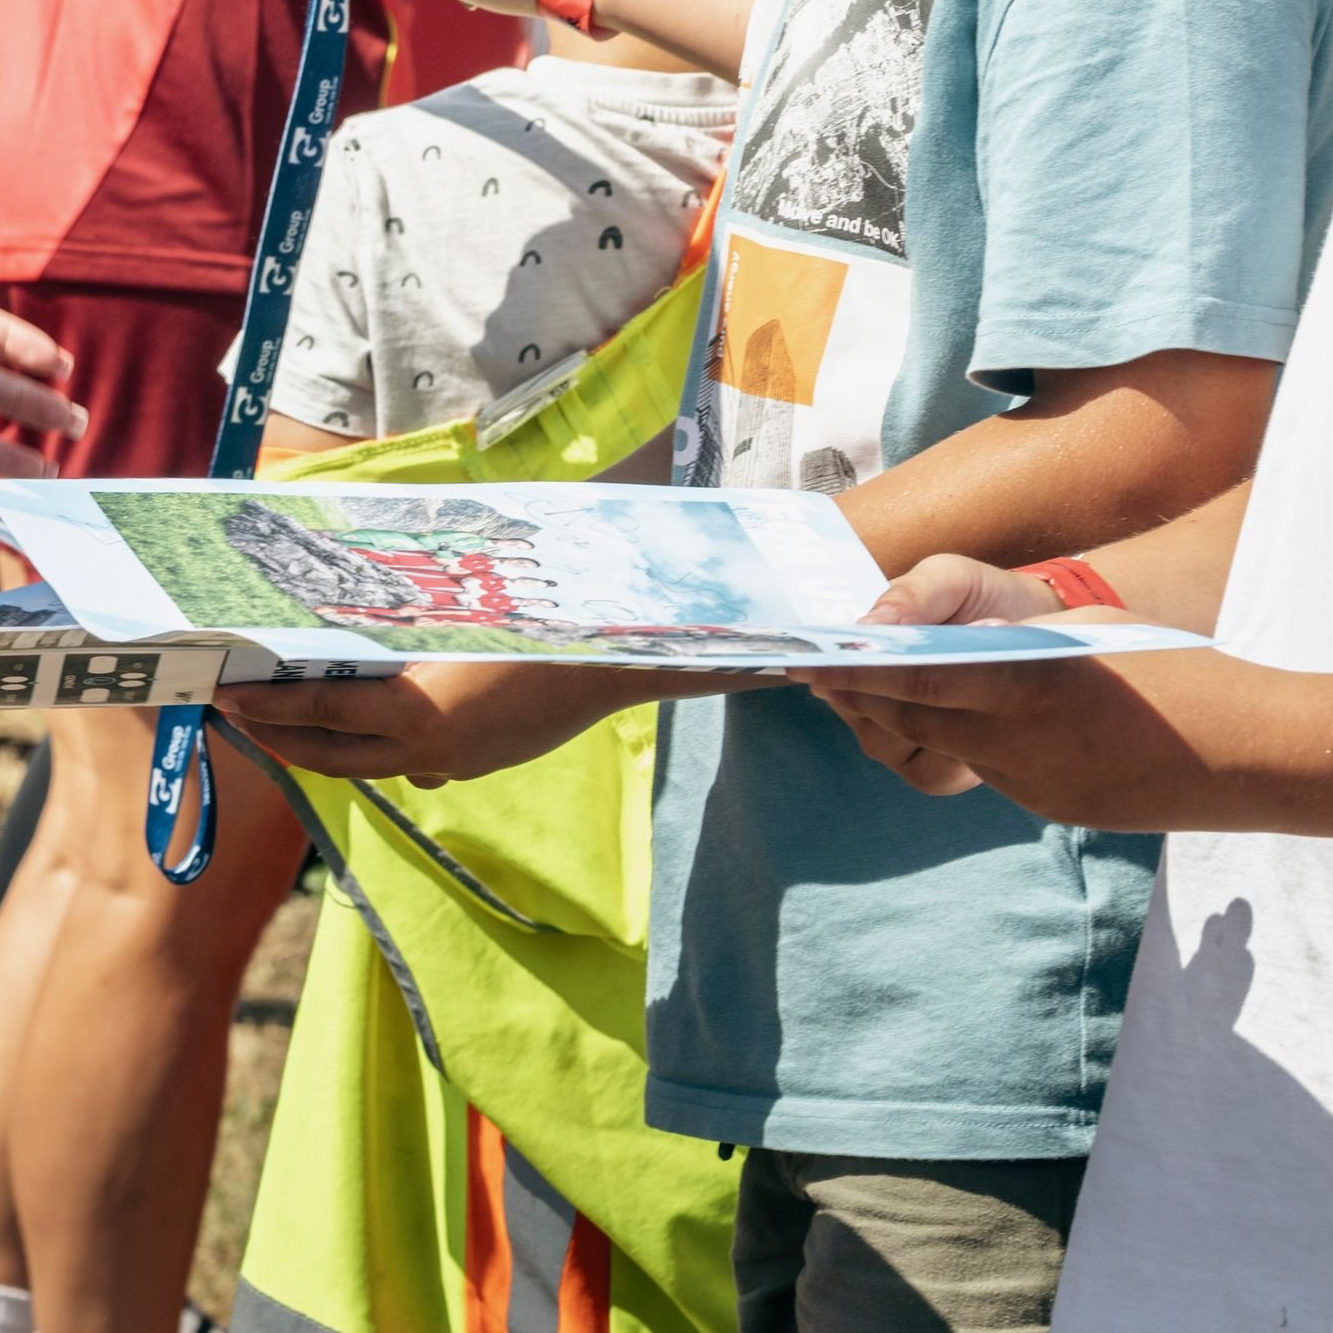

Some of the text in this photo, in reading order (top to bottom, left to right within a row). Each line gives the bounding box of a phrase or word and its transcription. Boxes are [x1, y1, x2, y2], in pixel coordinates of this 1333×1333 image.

[308, 78, 331, 125] Group
[279, 210, 303, 254] Group
[826, 212, 861, 234] and
[863, 219, 881, 240] be
[250, 340, 274, 384] Group
[162, 725, 183, 770] Group
